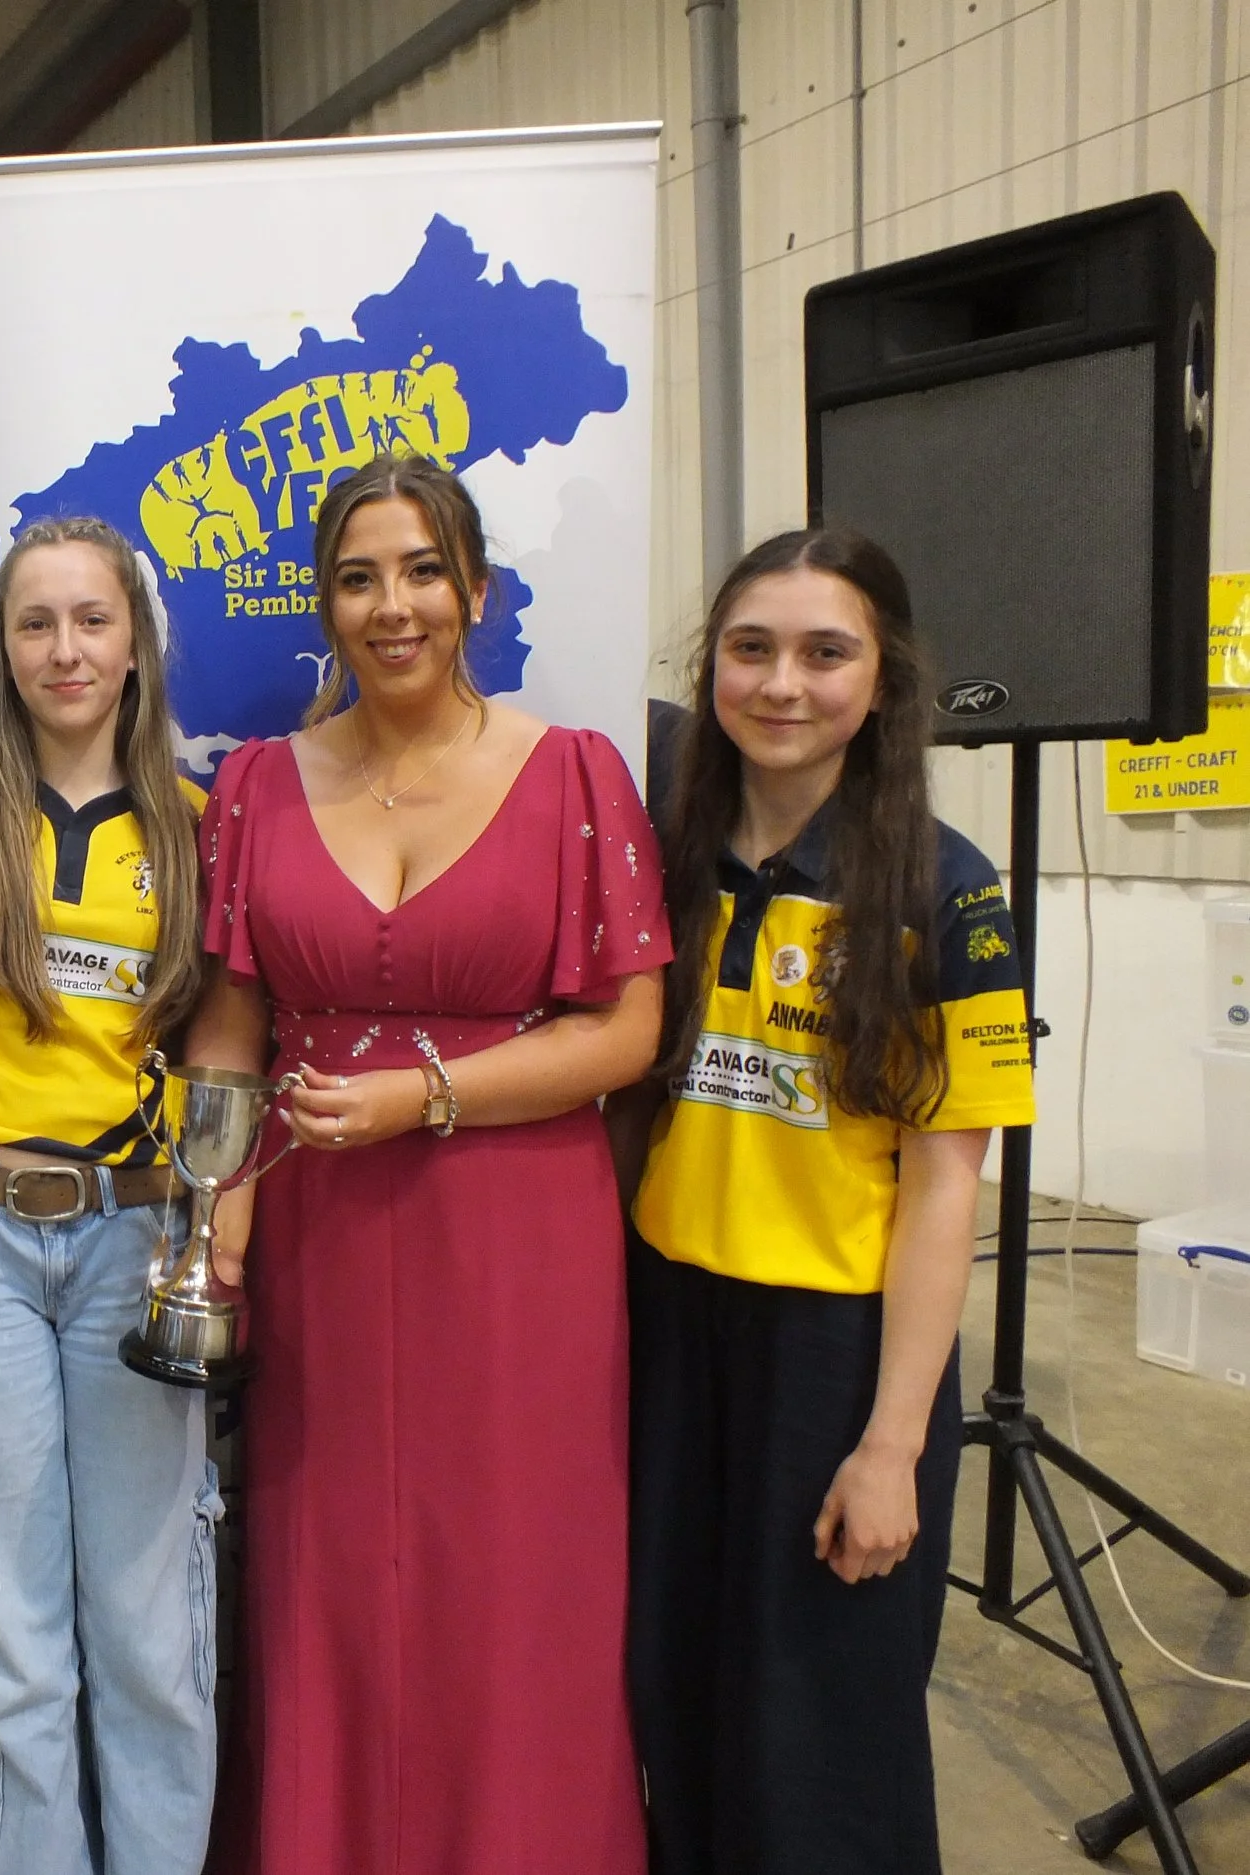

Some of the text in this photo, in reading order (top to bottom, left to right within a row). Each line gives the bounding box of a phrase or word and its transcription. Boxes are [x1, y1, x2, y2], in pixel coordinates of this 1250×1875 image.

[225, 561, 318, 589] Sir Be
[225, 588, 321, 618] Pembr
[1118, 755, 1172, 774] CREFFT
[1186, 749, 1238, 769] CRAFT
[1134, 779, 1220, 799] 21 & UNDER
[115, 850, 147, 865] KEYST
[44, 946, 109, 971] AVAGE
[49, 977, 104, 992] ontractor
[766, 1000, 830, 1037] ANNAB
[962, 1023, 1015, 1040] BELTON
[698, 1080, 771, 1105] Contractor
